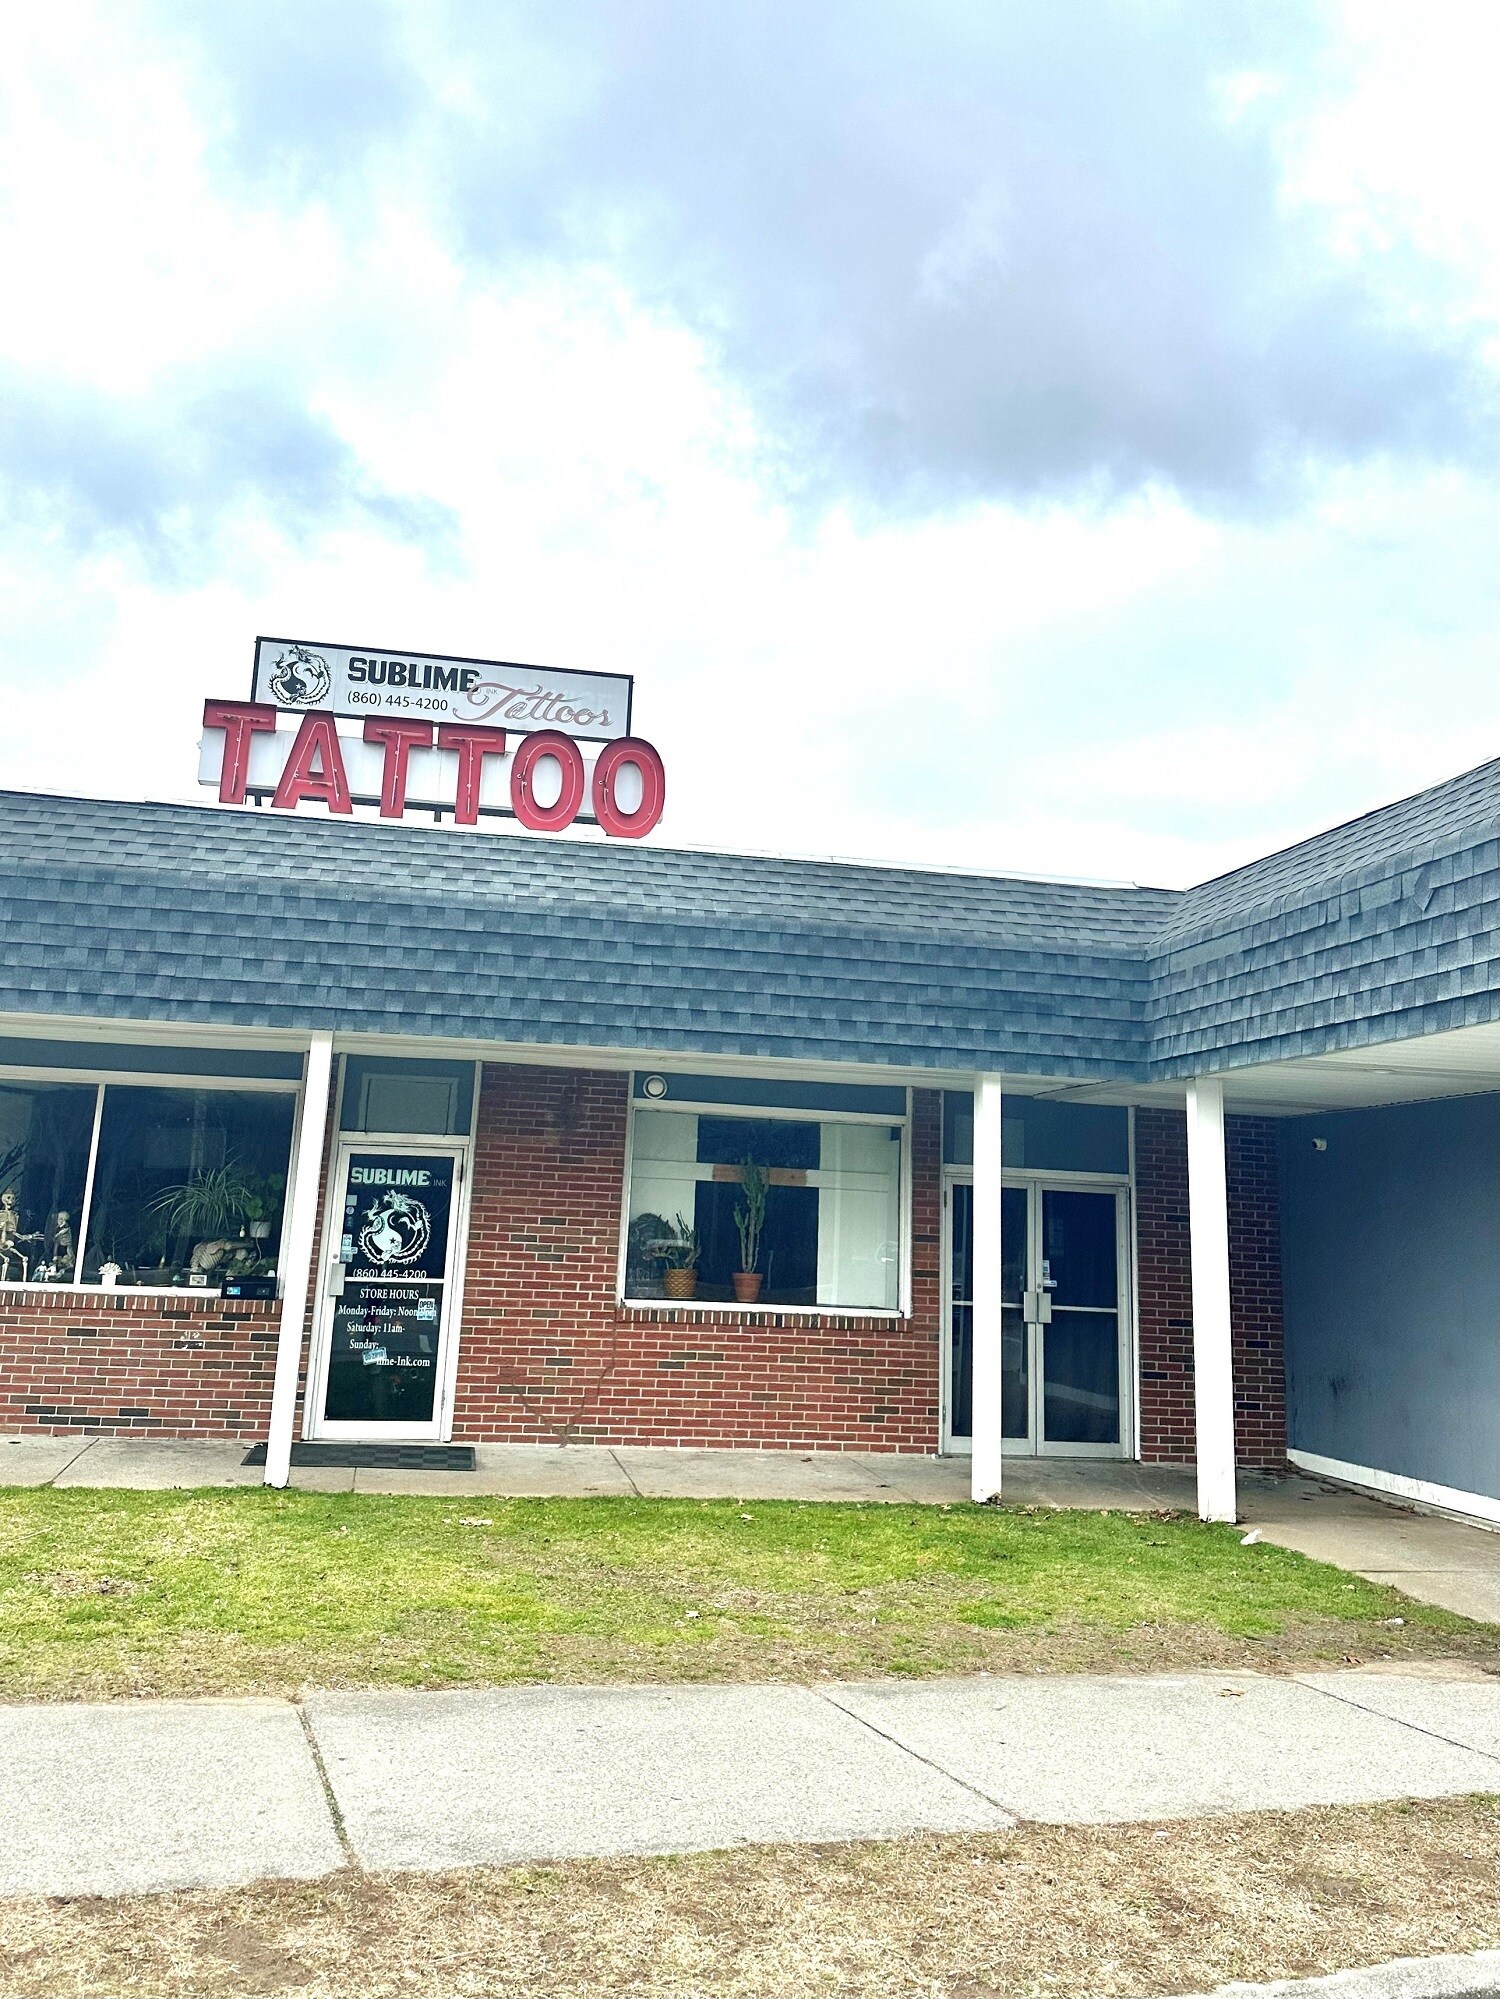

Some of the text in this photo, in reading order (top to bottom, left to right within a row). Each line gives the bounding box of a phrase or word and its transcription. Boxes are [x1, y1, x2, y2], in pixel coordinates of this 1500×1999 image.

[347, 656, 482, 695] SUBLIME
[347, 690, 449, 711] (860) 445-4200
[452, 682, 614, 727] Tattoos
[203, 698, 665, 839] TATTOO
[351, 1167, 448, 1187] SUBLIME INK
[353, 1268, 427, 1280] (860) 445-4200
[360, 1288, 420, 1300] STORE HOURS
[338, 1304, 397, 1319] Monday-Friday:
[346, 1321, 381, 1335] Saturday:
[349, 1339, 379, 1352] Sunday:
